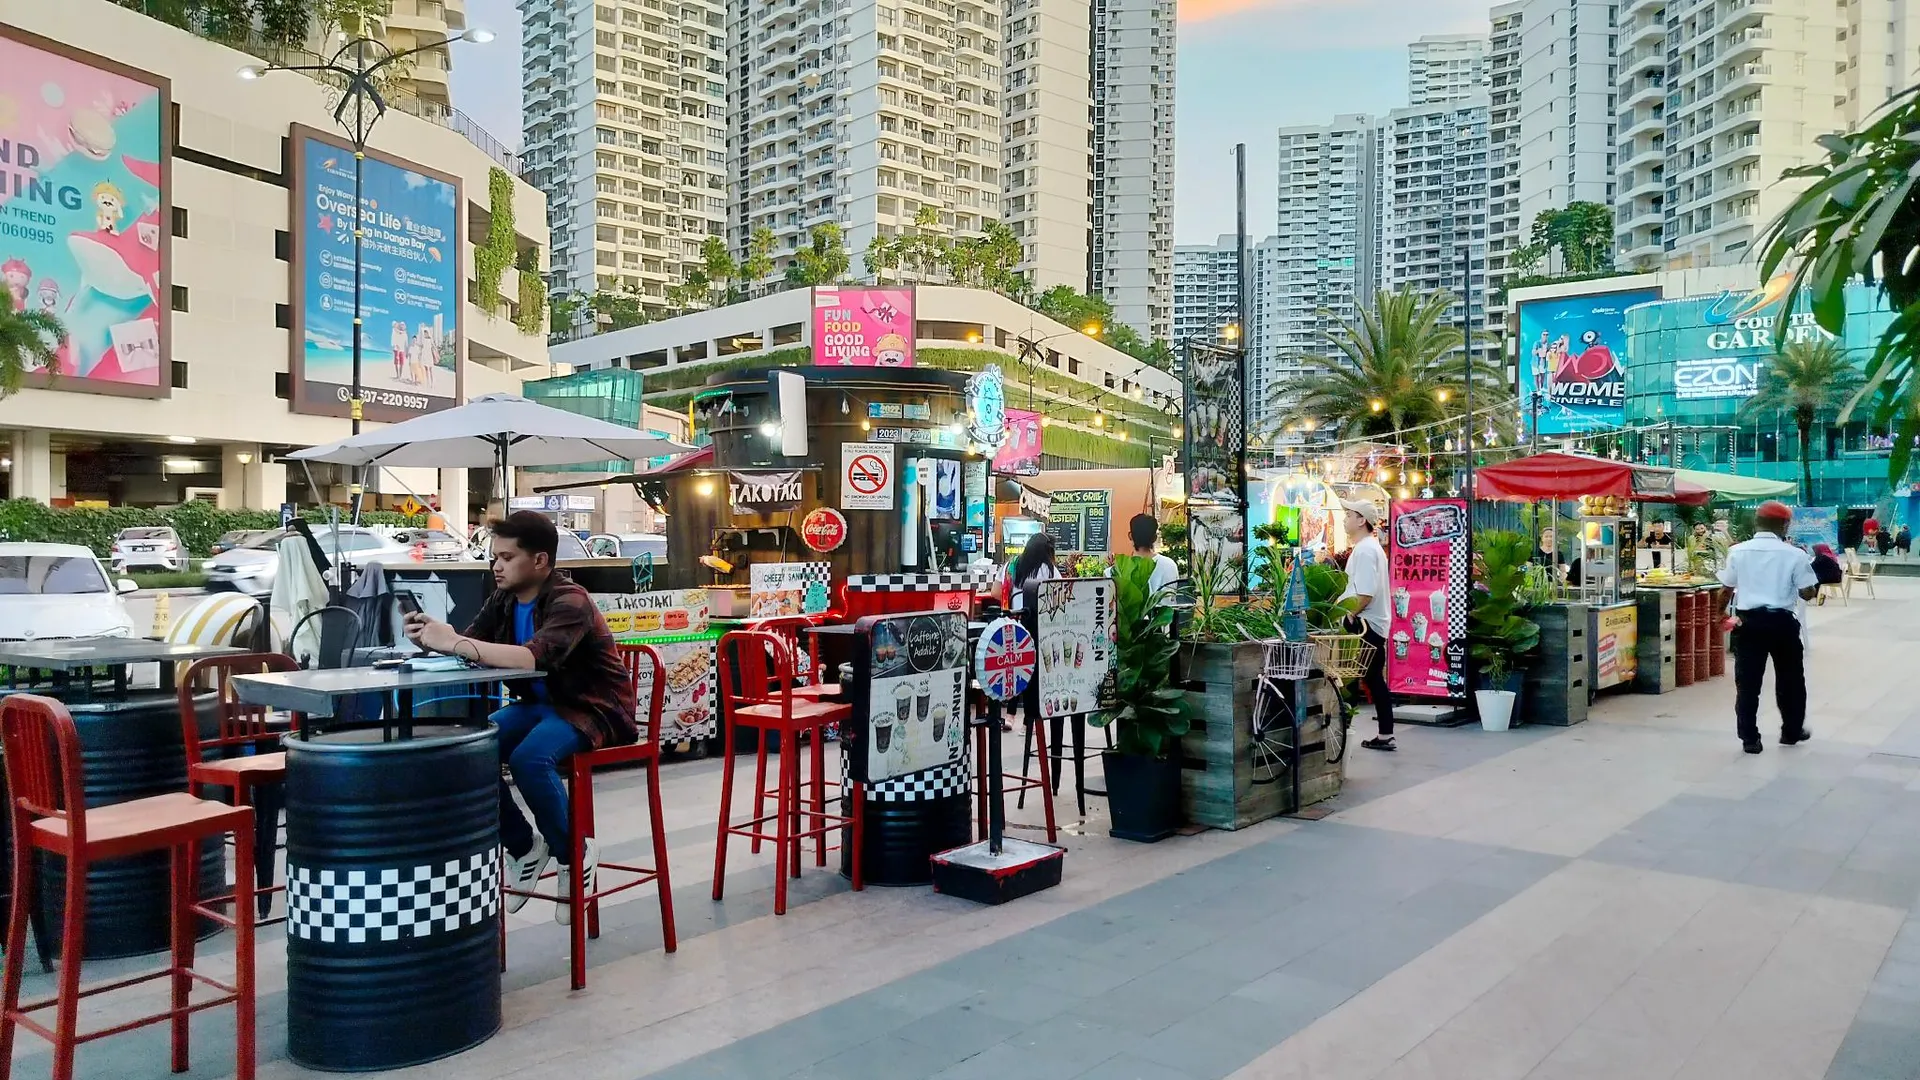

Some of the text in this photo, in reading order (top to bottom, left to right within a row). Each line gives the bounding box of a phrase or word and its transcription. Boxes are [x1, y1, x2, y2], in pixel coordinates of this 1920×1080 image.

[0, 170, 82, 210] ING
[318, 184, 335, 196] Enjoy
[12, 207, 56, 226] TREND
[316, 194, 402, 231] Oversea Life
[0, 221, 54, 244] 060995
[337, 217, 426, 252] By Liing In Danga Bay
[824, 309, 851, 322] FUN
[824, 321, 861, 333] FOOD
[824, 334, 864, 346] GOOD
[824, 346, 870, 357] LIVING
[1674, 363, 1758, 388] EZON
[403, 394, 429, 410] 9957
[878, 428, 899, 438] 2023
[730, 482, 802, 503] TAKOYAKI
[1394, 553, 1447, 568] COFFEE
[764, 573, 785, 583] CHEEZY
[1394, 567, 1446, 582] FRAPPE
[614, 594, 672, 610] TAKOYAKI
[1095, 586, 1105, 630] DRINK
[914, 645, 937, 658] Addict
[997, 653, 1023, 666] CALM
